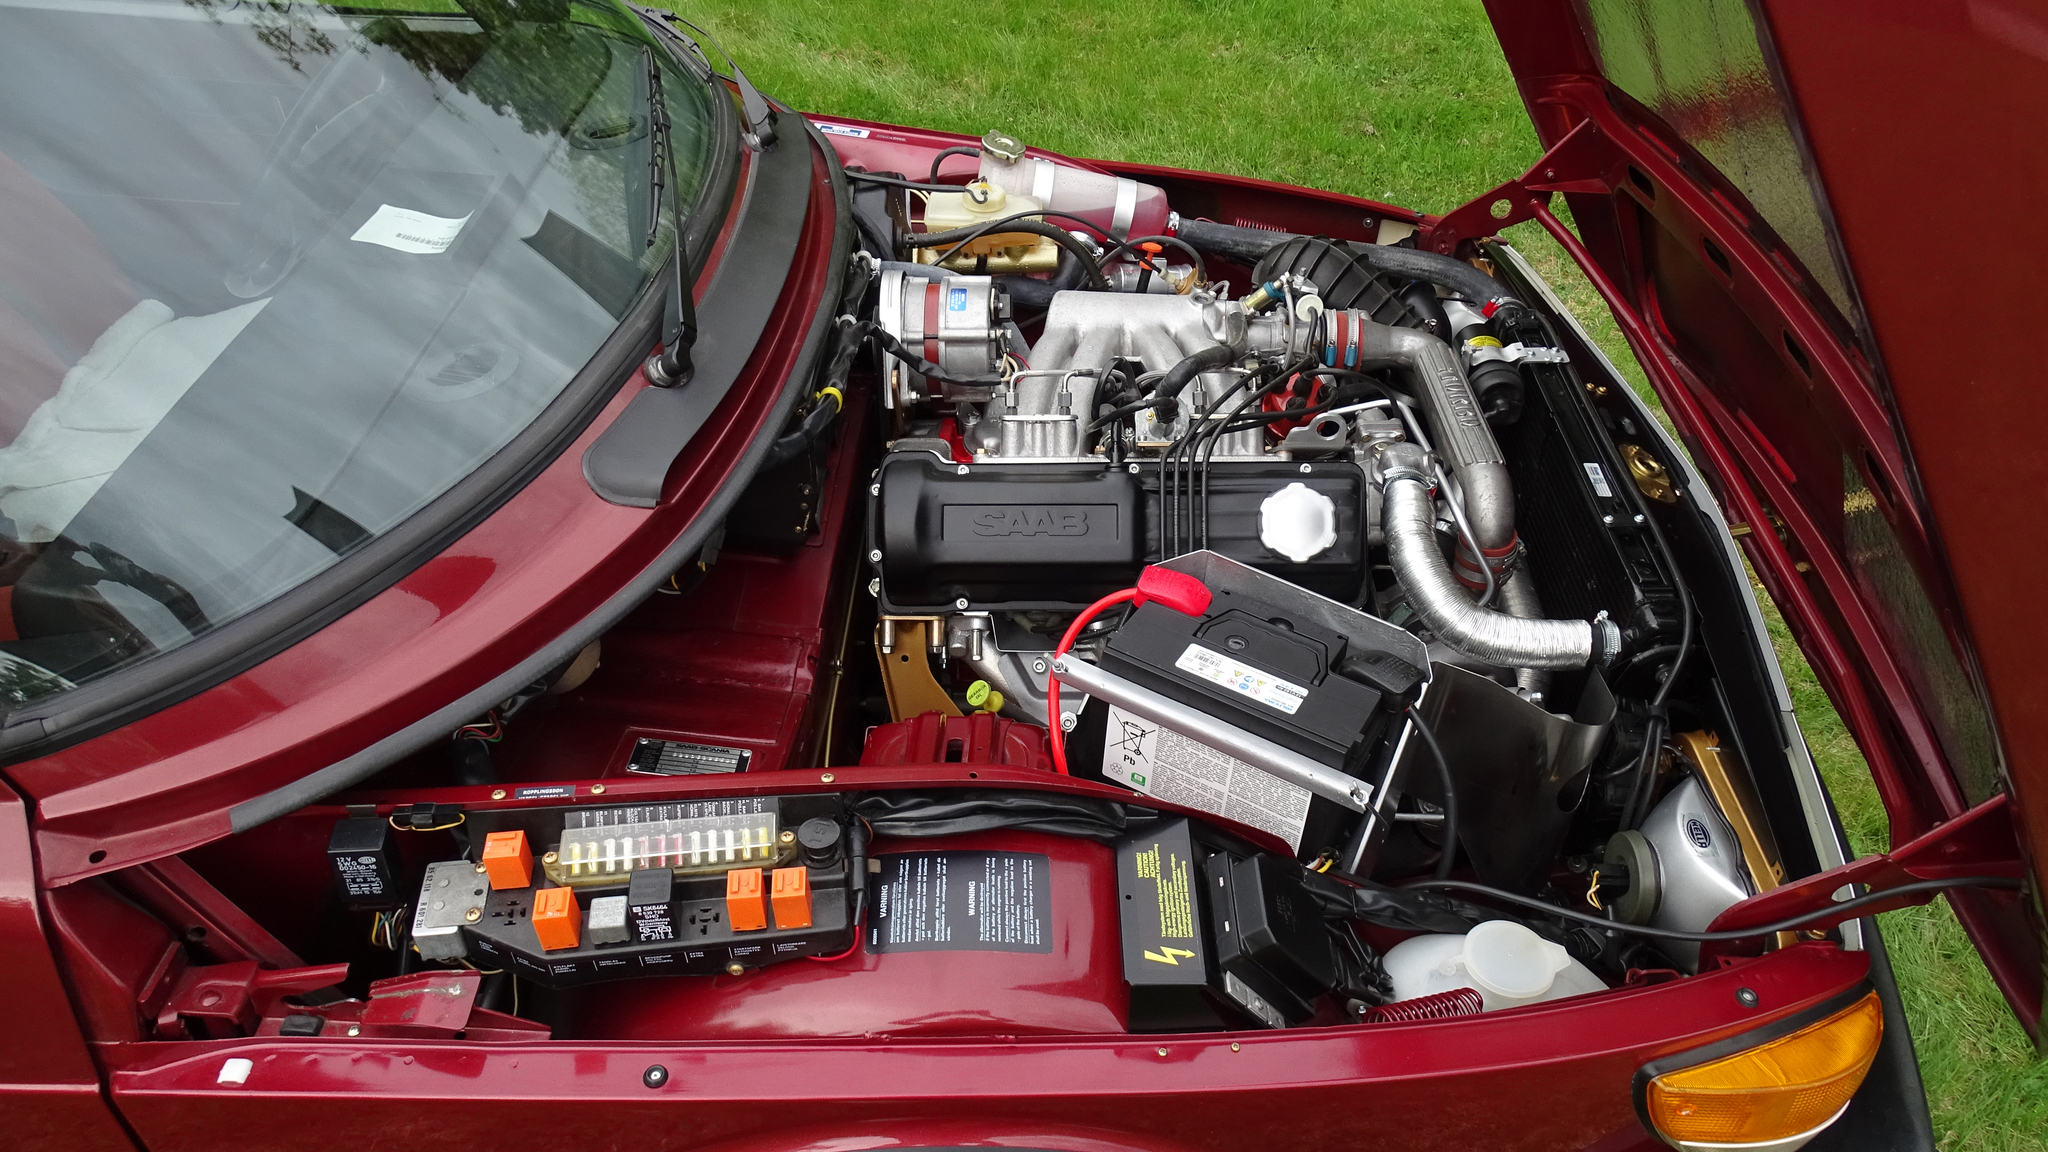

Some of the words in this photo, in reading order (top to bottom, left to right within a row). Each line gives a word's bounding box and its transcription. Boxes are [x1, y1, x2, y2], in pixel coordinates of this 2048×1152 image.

[1438, 364, 1481, 427] TURBO
[972, 509, 1089, 536] SAAB
[1124, 754, 1136, 766] Pb
[1690, 821, 1708, 848] HELLA
[880, 885, 888, 918] VARNING
